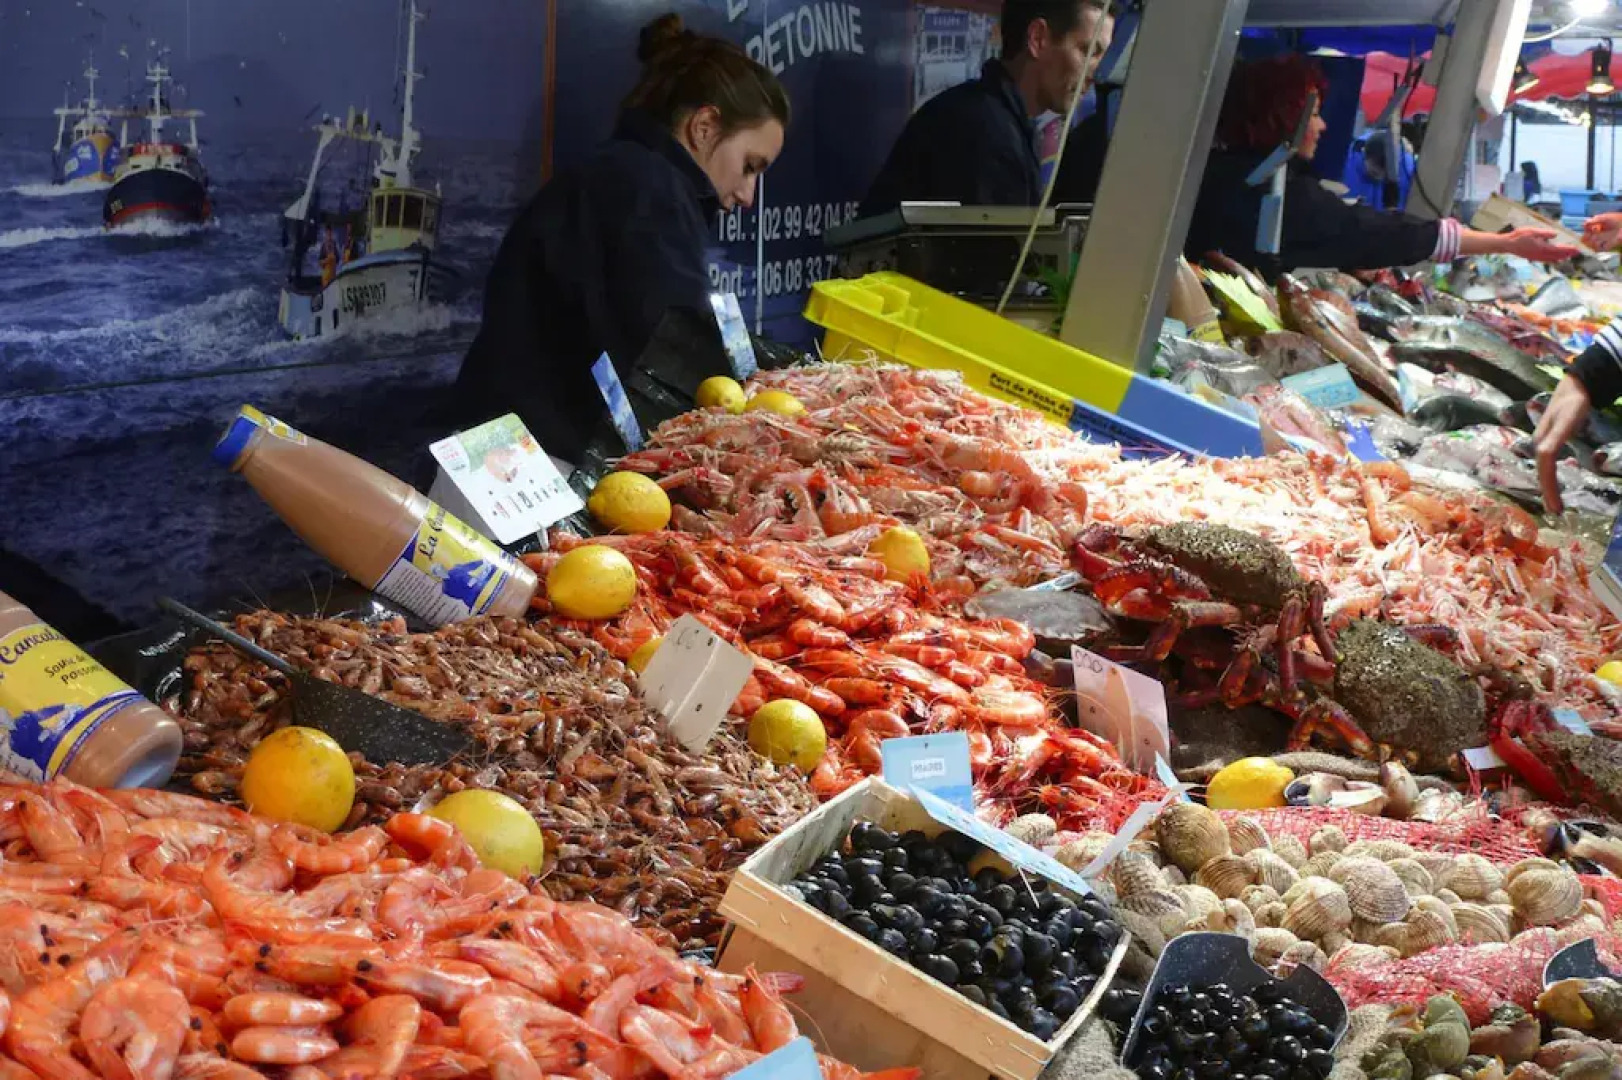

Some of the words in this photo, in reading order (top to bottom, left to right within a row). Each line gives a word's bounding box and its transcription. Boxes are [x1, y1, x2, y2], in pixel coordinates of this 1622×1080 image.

[763, 208, 781, 241] 02
[784, 206, 802, 239] 99
[805, 204, 822, 236] 42
[825, 203, 841, 228] 04
[764, 262, 782, 295] 06
[785, 259, 803, 292] 08
[806, 257, 823, 289] 33
